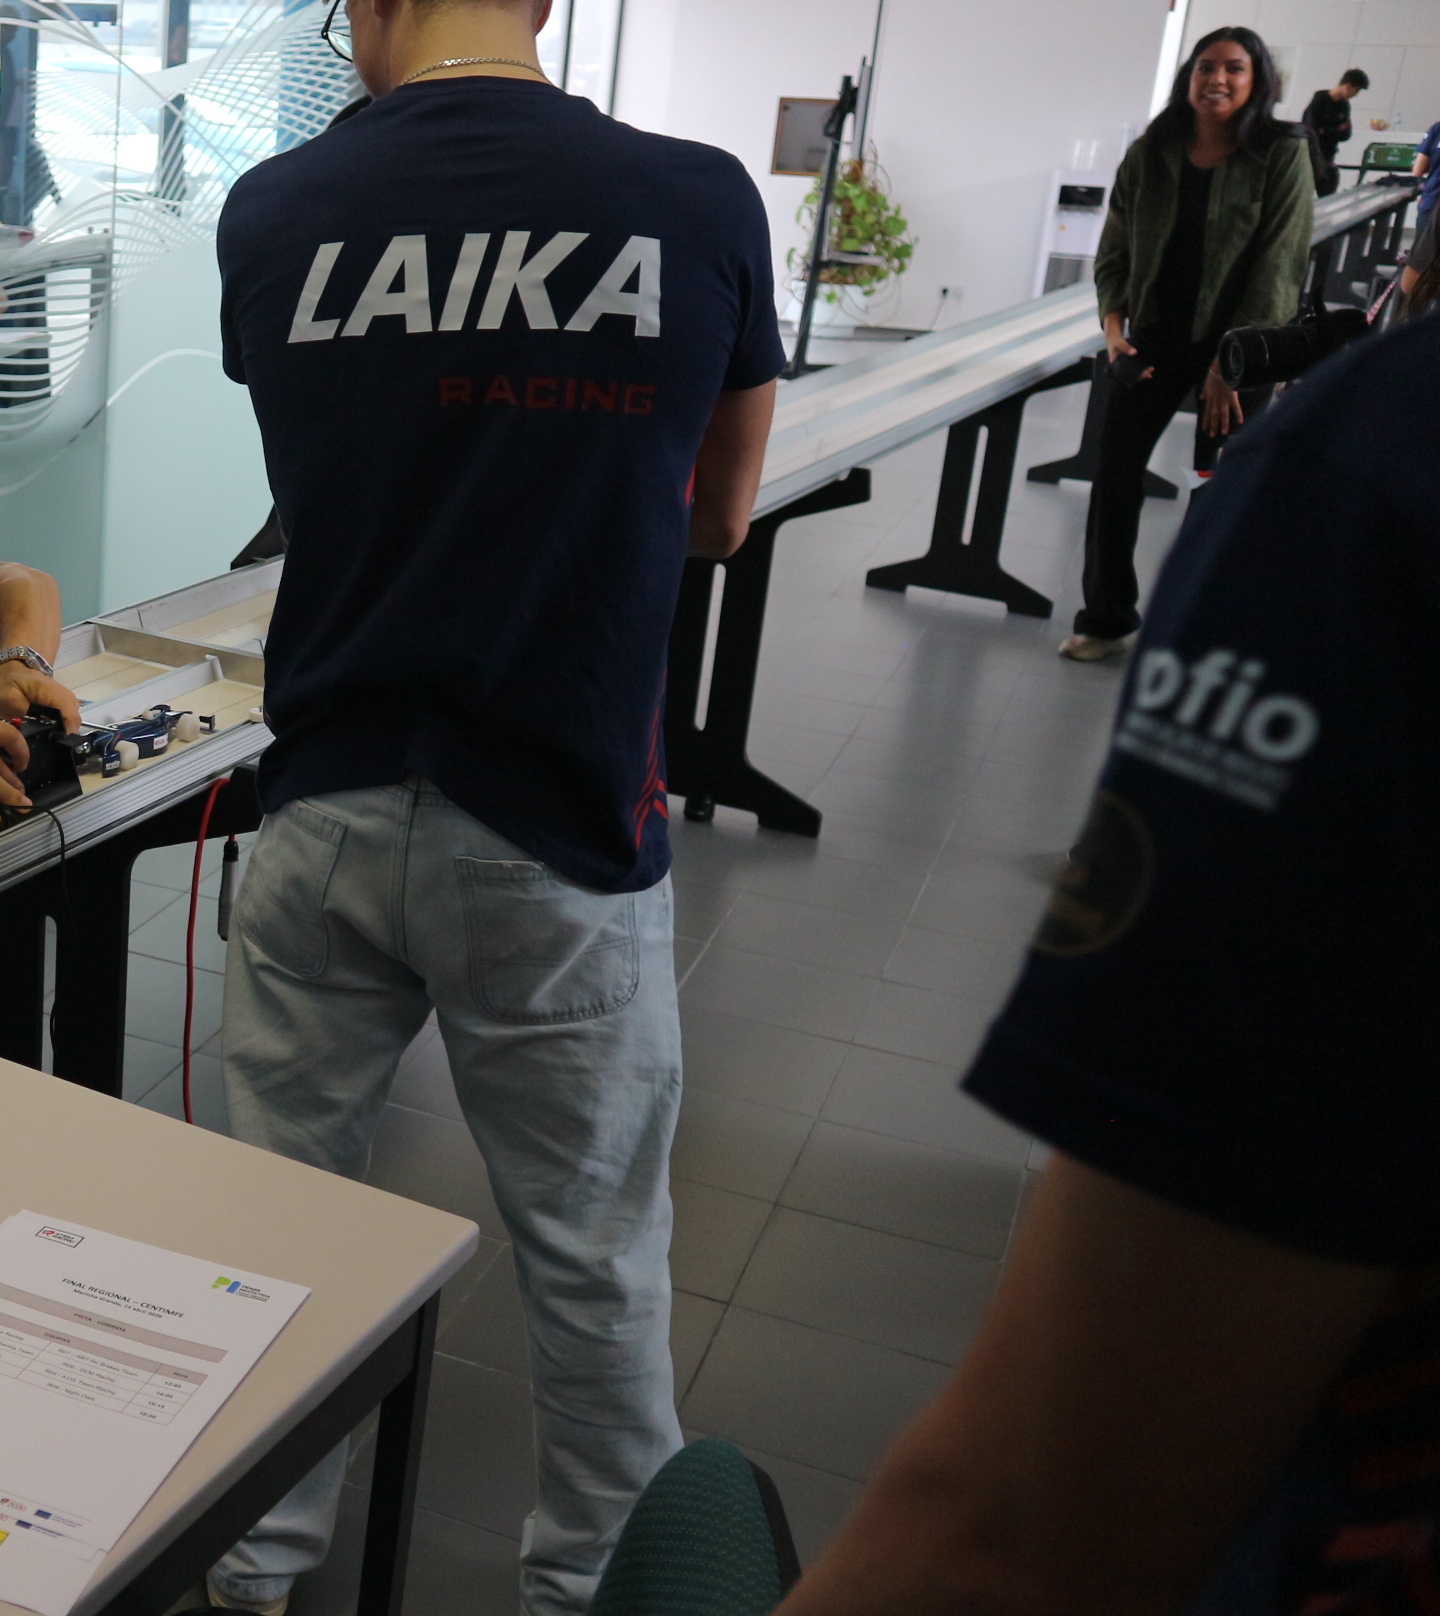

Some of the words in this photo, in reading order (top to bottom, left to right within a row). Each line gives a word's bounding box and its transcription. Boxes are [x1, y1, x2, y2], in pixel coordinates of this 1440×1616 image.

[287, 230, 661, 344] LAIKA
[436, 374, 658, 416] RACING
[61, 1278, 87, 1288] FINAL
[86, 1286, 132, 1302] REGIONAL
[139, 1301, 185, 1318] CENTIMFE
